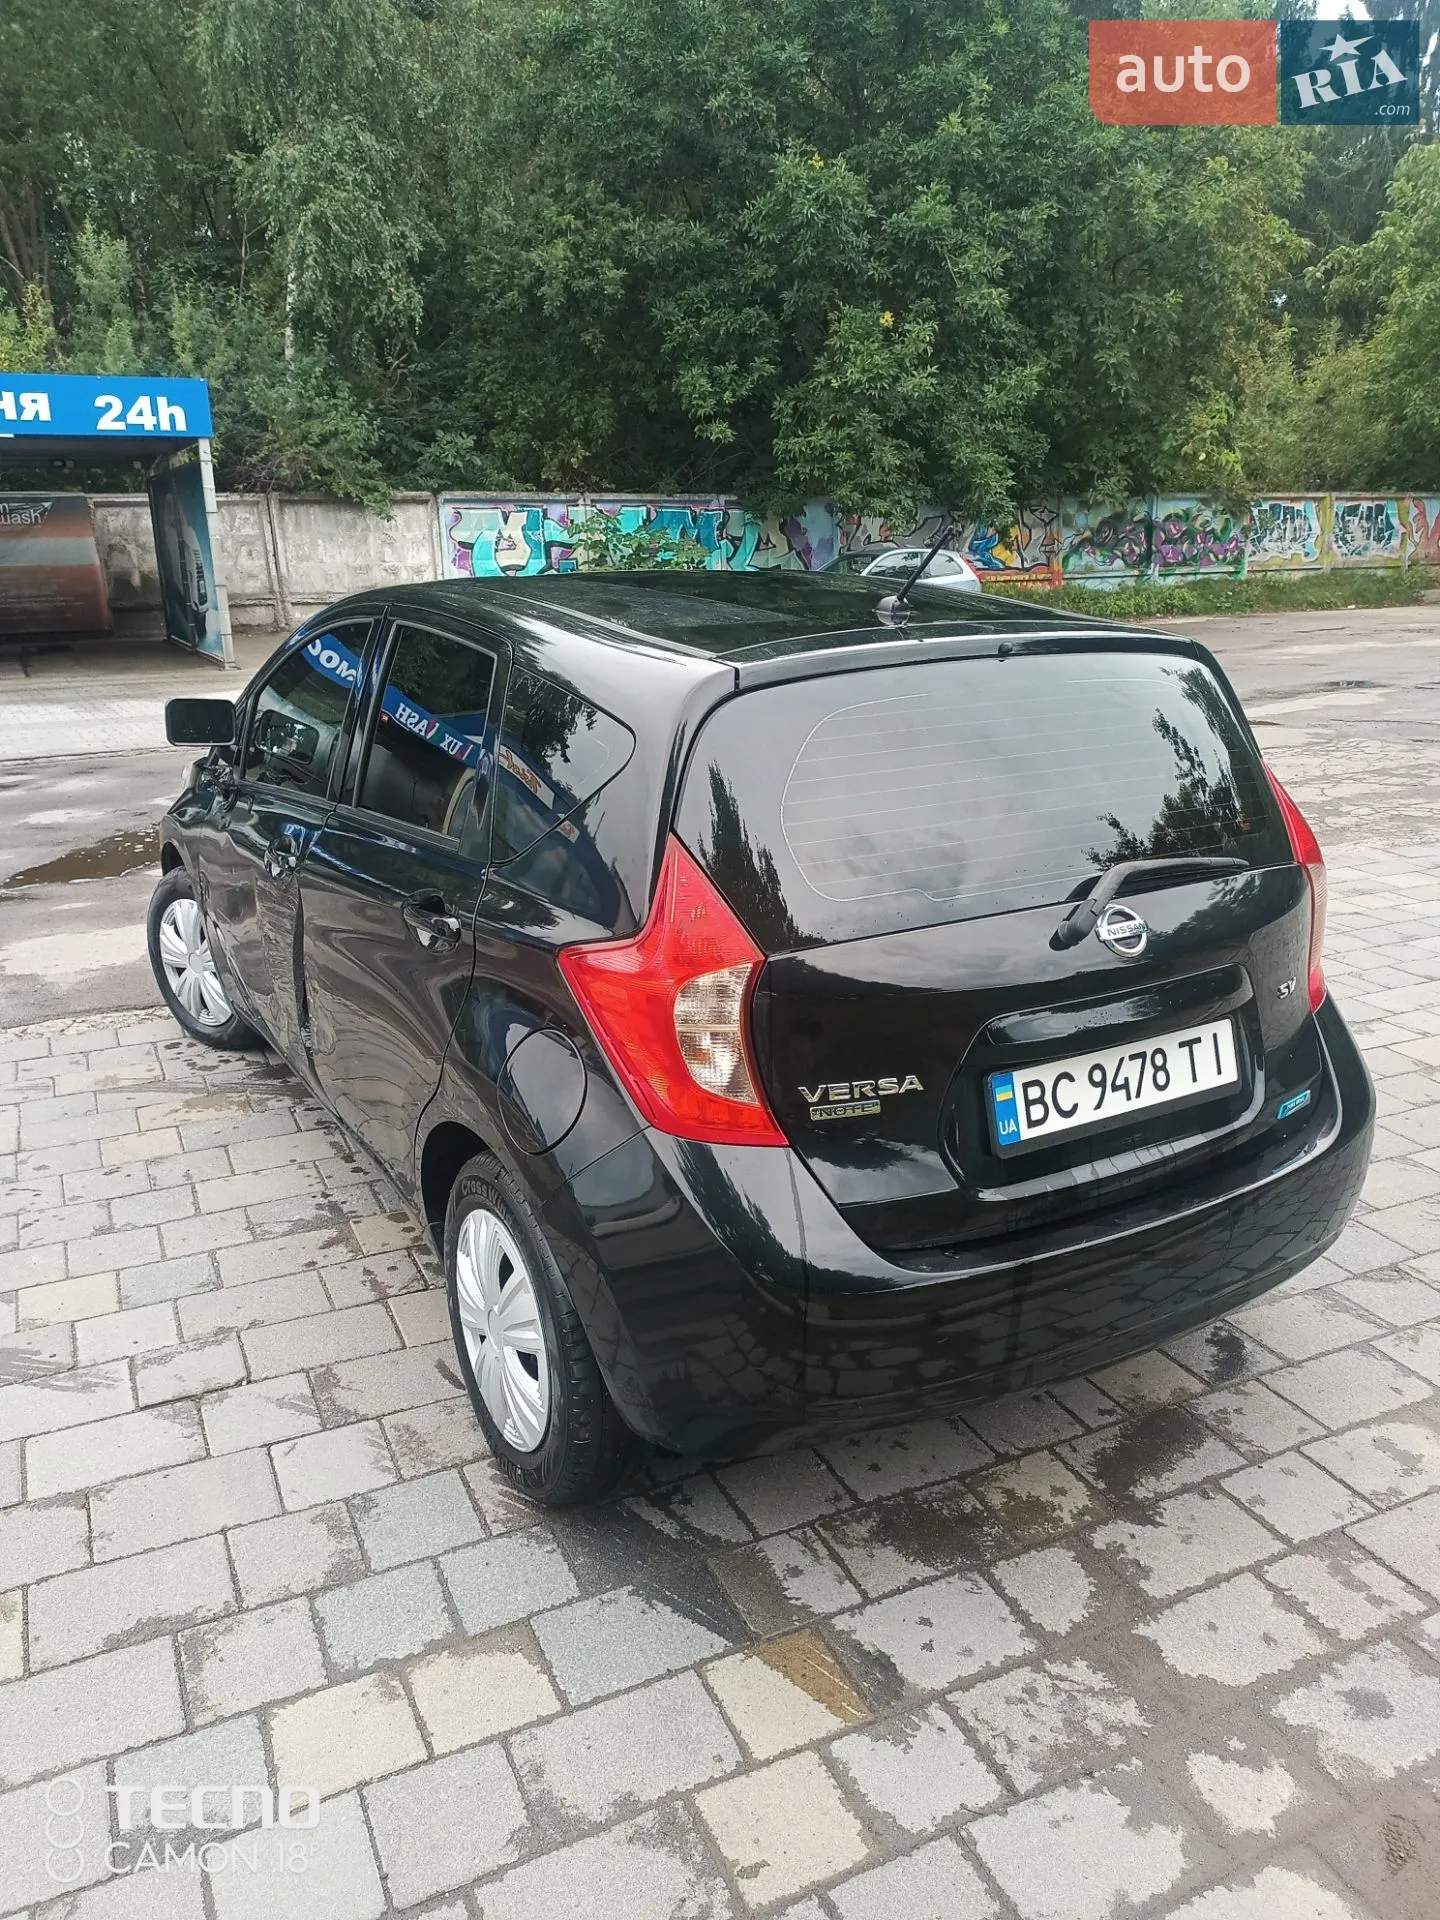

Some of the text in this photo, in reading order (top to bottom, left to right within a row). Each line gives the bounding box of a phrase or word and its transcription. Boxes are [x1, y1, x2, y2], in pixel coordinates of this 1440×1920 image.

[94, 395, 187, 431] 24h
[1107, 922, 1146, 937] NISSAN
[798, 1075, 924, 1103] VERSA
[1022, 1072, 1079, 1129] BC
[1088, 1047, 1171, 1111] 9478
[999, 1118, 1018, 1135] UA
